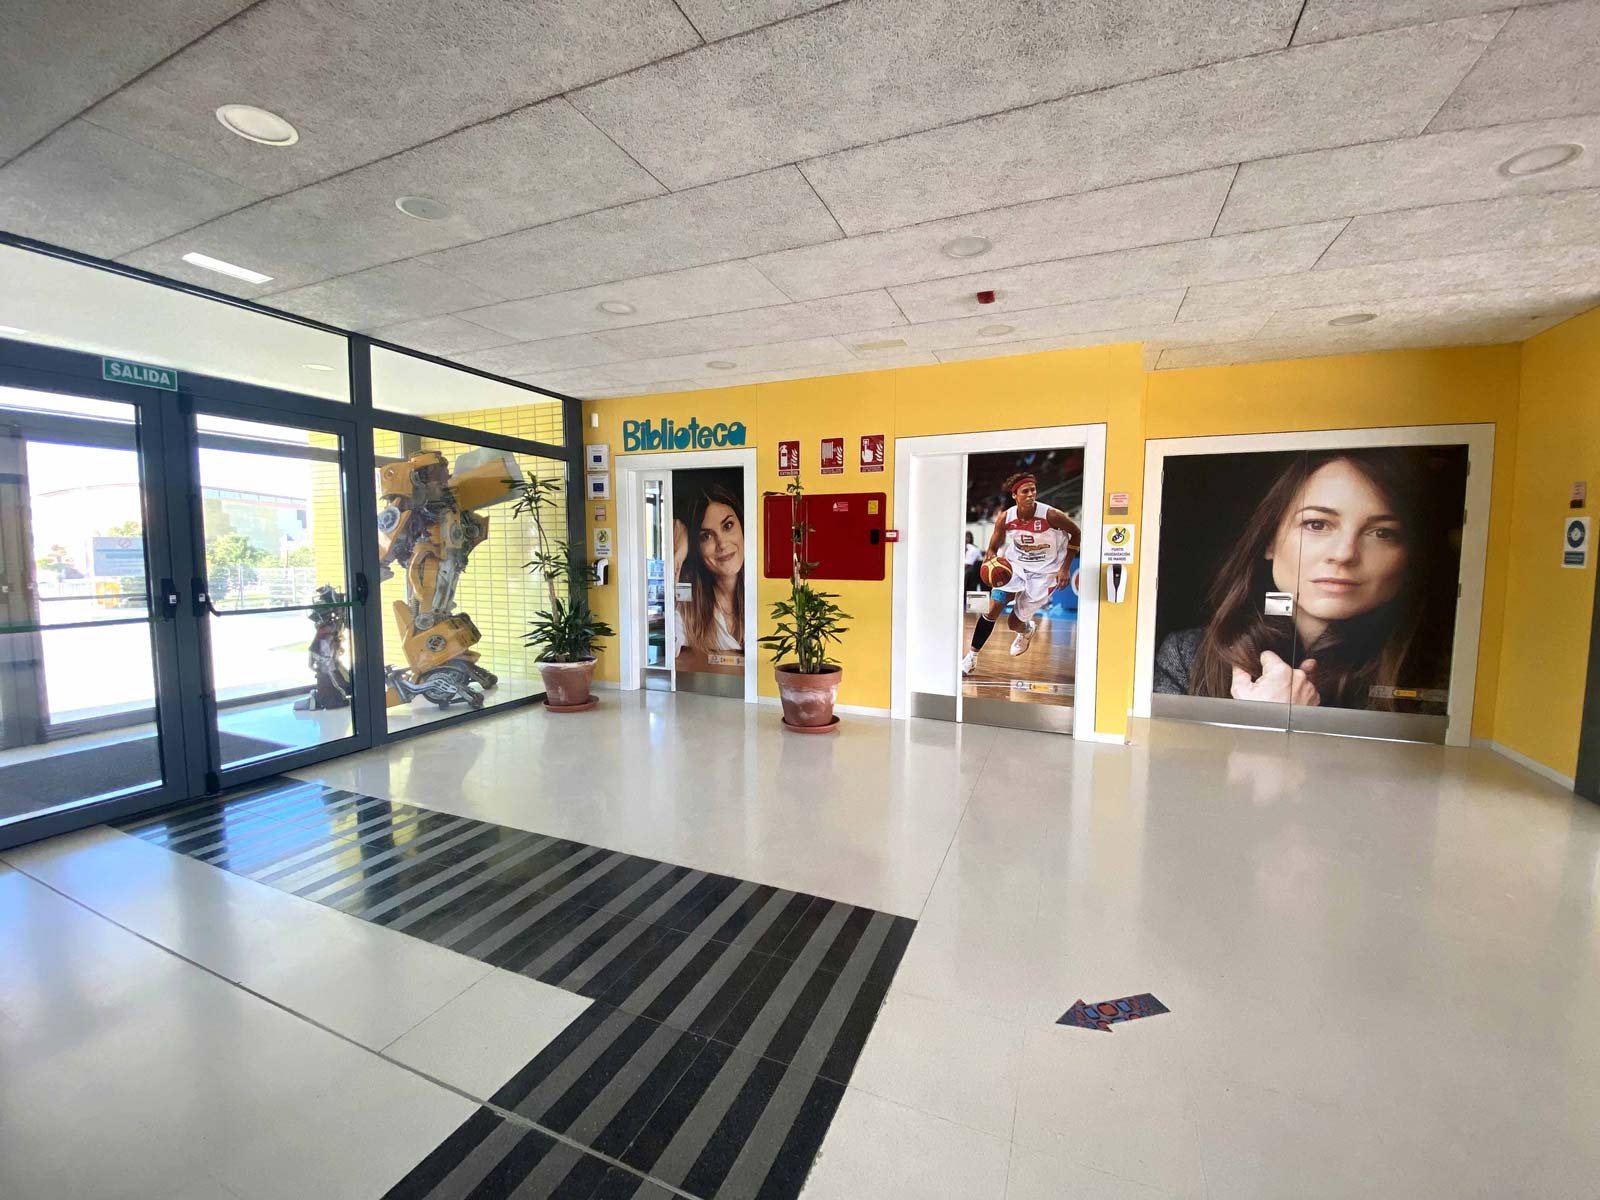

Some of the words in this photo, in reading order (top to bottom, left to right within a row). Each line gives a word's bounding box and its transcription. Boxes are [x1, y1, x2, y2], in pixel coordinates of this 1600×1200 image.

[110, 362, 171, 385] SALIDA
[622, 417, 747, 452] Biblioteca
[1020, 534, 1035, 544] 13
